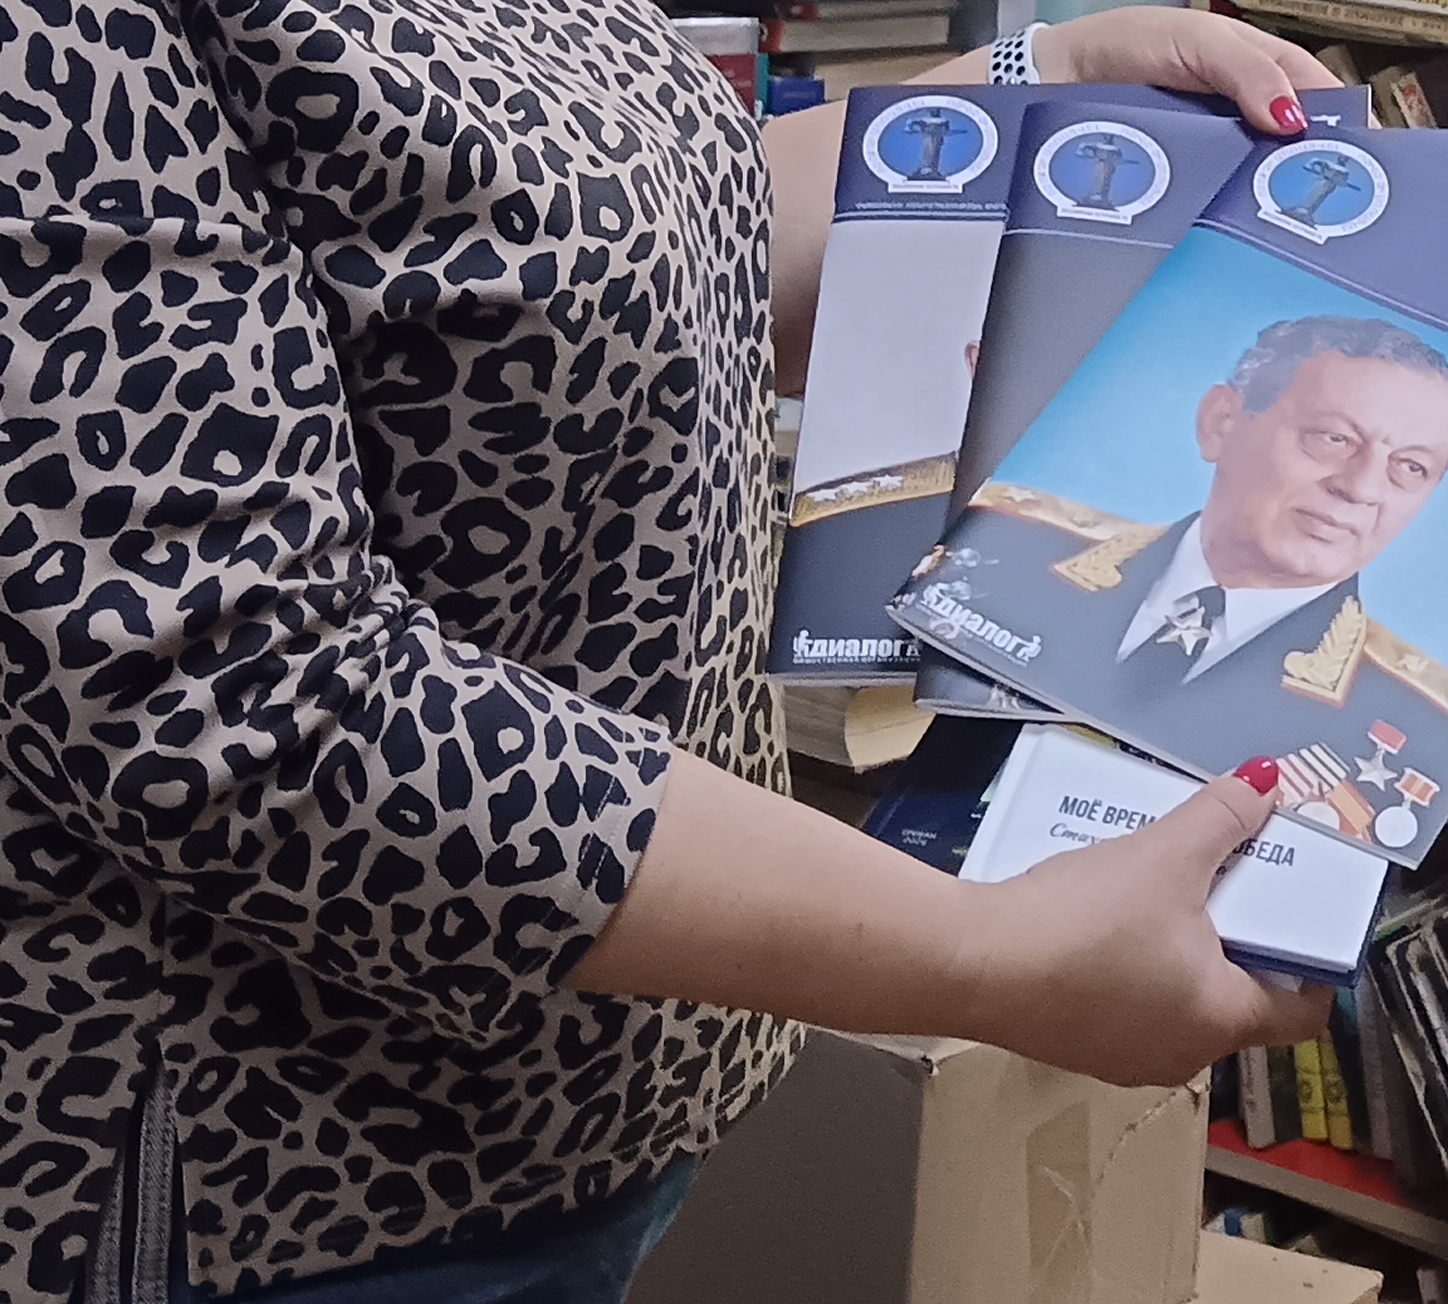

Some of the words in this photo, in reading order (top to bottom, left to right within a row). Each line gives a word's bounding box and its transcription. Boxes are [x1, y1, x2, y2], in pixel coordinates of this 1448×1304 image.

[1049, 822, 1104, 845] Стих
[1058, 795, 1103, 822] МОЁ
[1102, 803, 1157, 830] ВРЕМ
[1232, 836, 1296, 867] ОБЕДА
